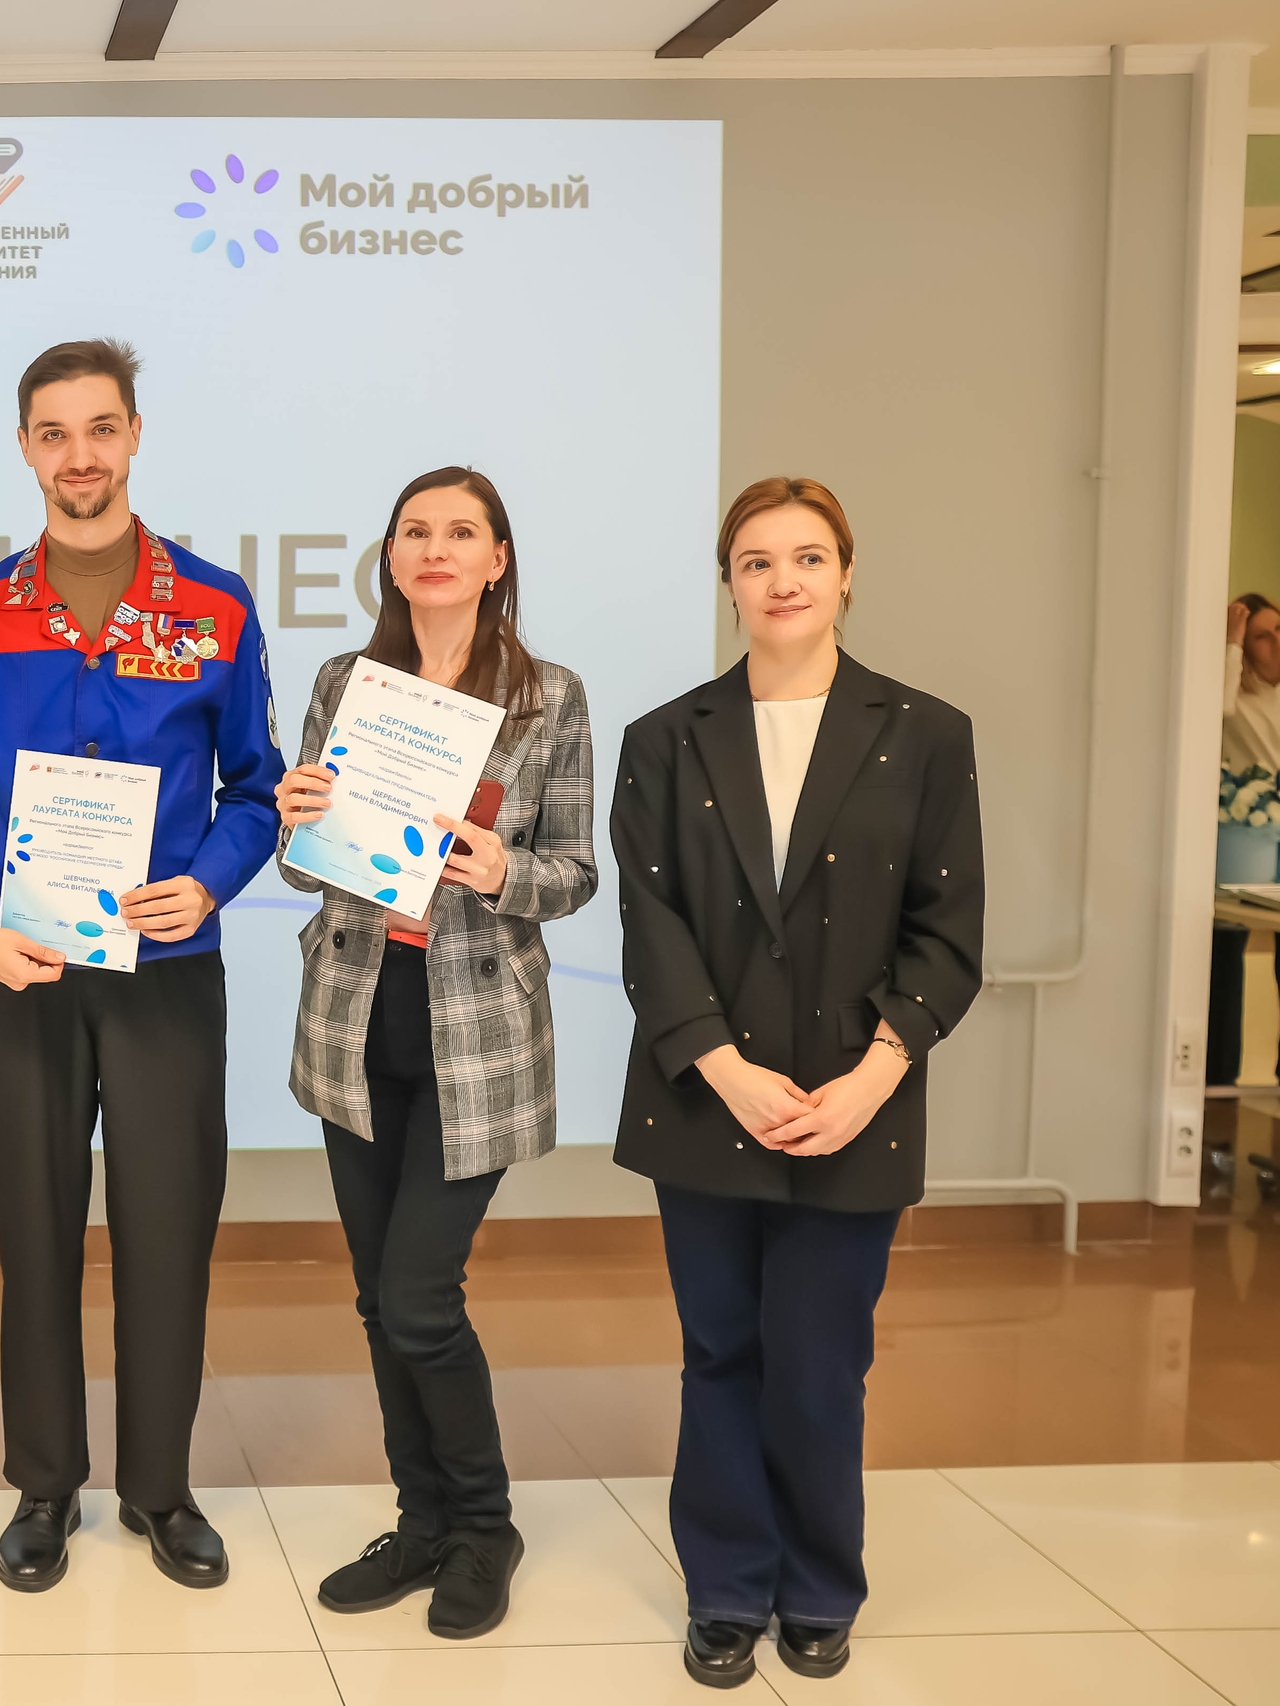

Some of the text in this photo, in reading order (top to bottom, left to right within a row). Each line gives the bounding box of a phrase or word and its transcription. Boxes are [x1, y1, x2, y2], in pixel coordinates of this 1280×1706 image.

[300, 173, 589, 217] Мой добрый
[299, 220, 464, 255] бизнес
[354, 717, 464, 765] ЛАУРЕАТА КОНКУРСА
[379, 713, 448, 746] СЕРТИФИКАТ
[53, 796, 115, 811] СЕРТИФИКАТ
[349, 790, 429, 826] ИВАН ВЛАДИМИРОВИЧ
[372, 788, 411, 809] ЩЕРБАКОВ
[32, 804, 133, 825] ЛАУРЕАТА КОНКУРСА
[47, 881, 70, 889] АЛИСА
[64, 874, 100, 885] ШЕВЧЕНКО
